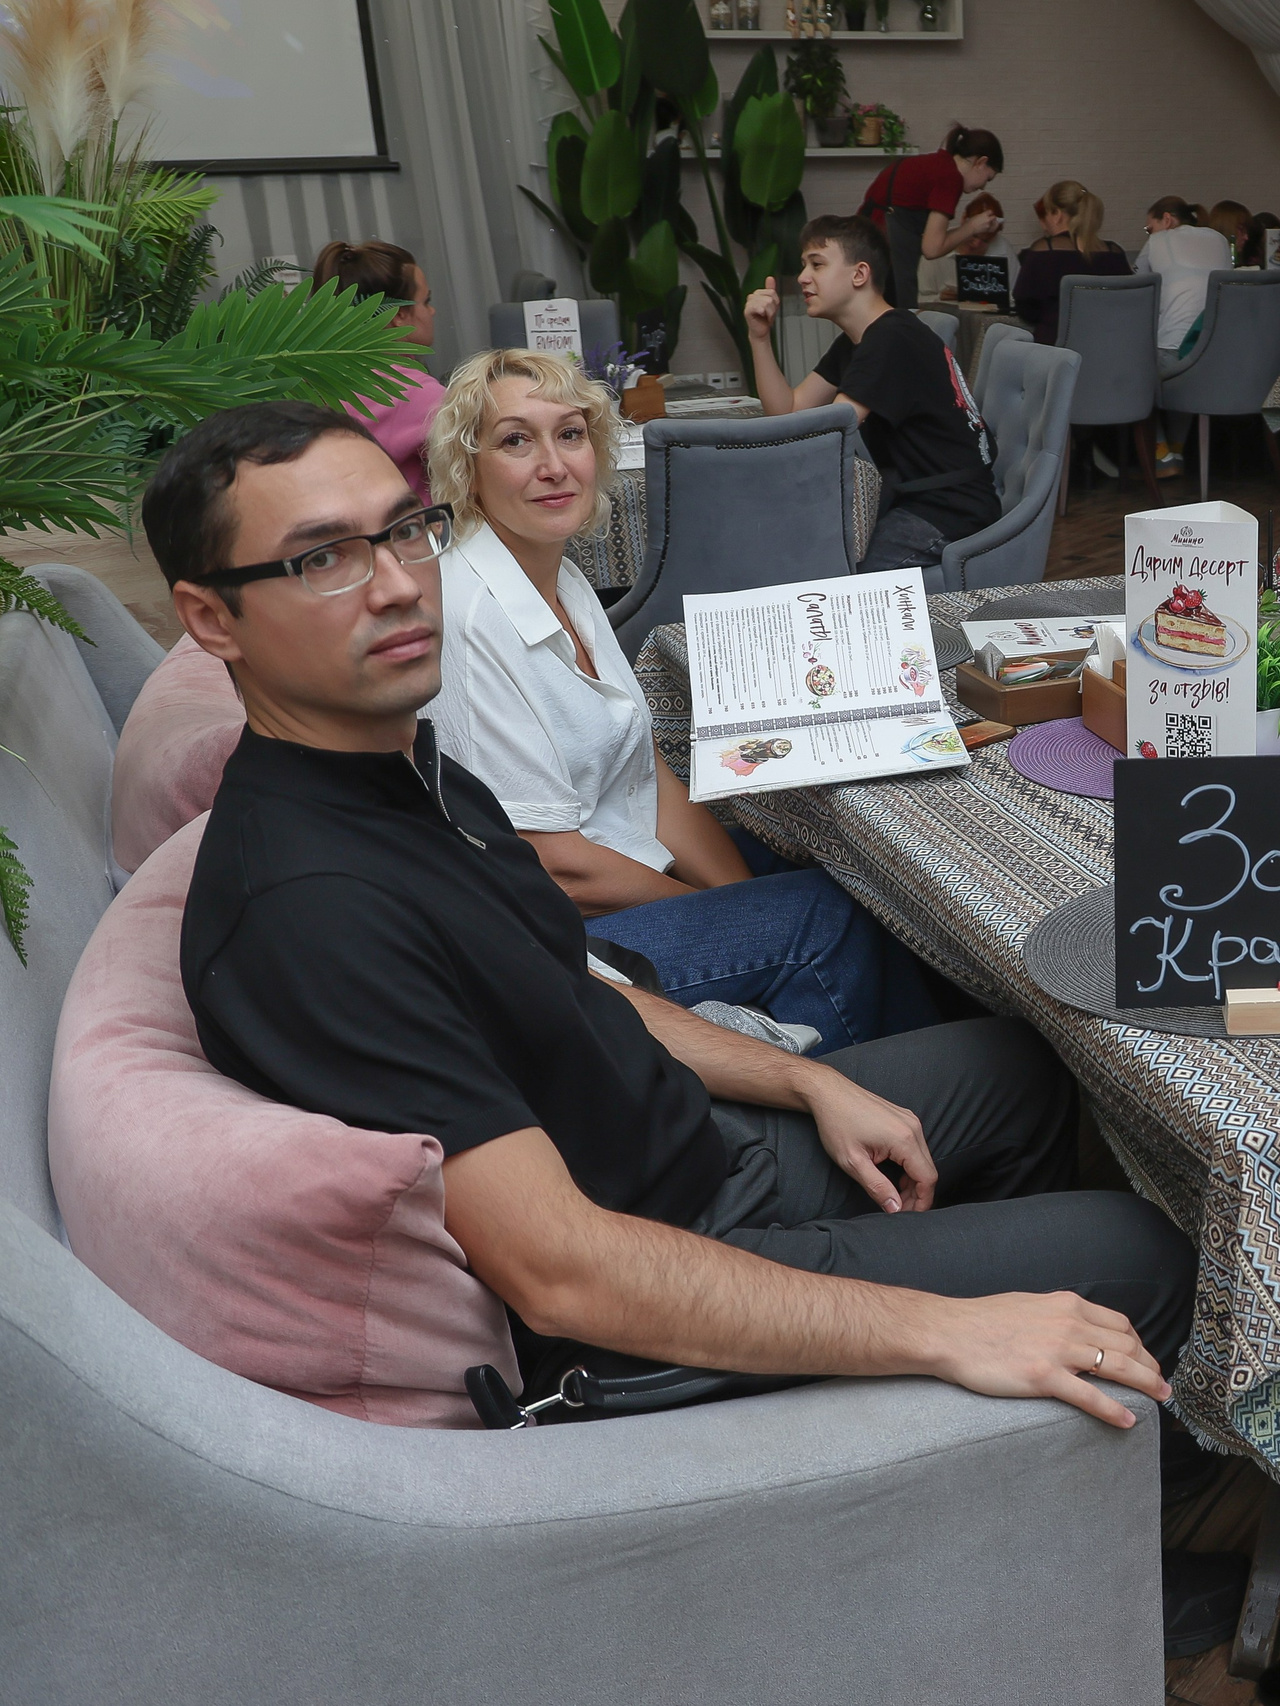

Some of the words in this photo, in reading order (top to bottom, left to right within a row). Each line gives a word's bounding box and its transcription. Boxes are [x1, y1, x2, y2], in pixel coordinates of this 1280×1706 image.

[1130, 545, 1184, 583] Дарим
[797, 592, 832, 641] Салаты
[895, 585, 915, 631] Хинкали
[1149, 678, 1167, 704] за
[1174, 677, 1230, 709] отзыв!
